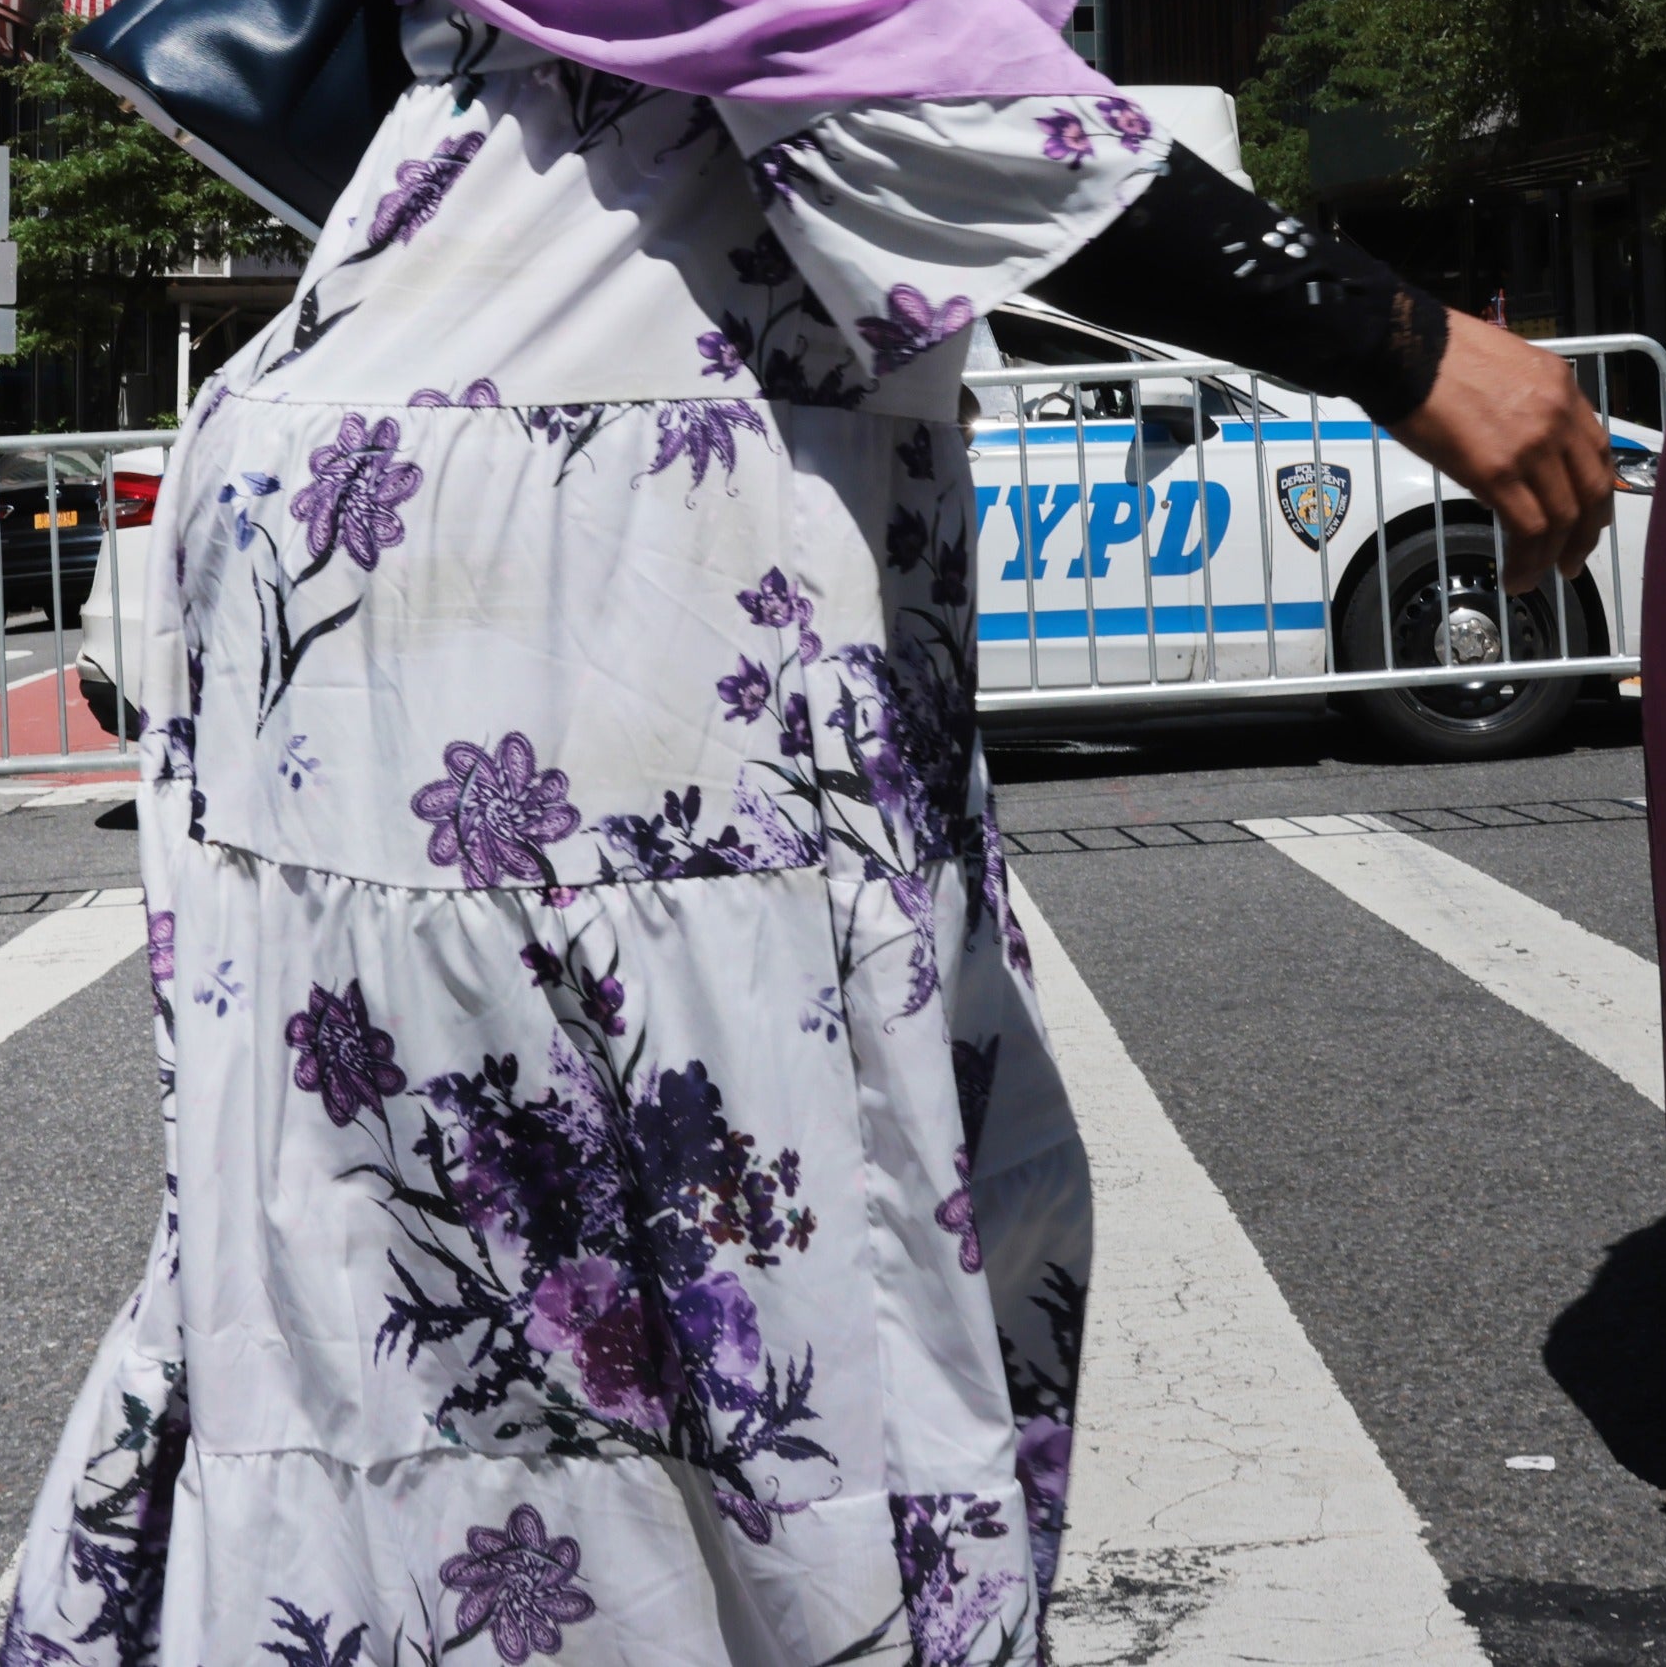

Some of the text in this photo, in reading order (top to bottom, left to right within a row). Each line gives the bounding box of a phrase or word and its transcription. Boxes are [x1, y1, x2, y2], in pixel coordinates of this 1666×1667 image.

[1281, 497, 1305, 534] CITY OF
[1325, 494, 1348, 538] NEW YORK
